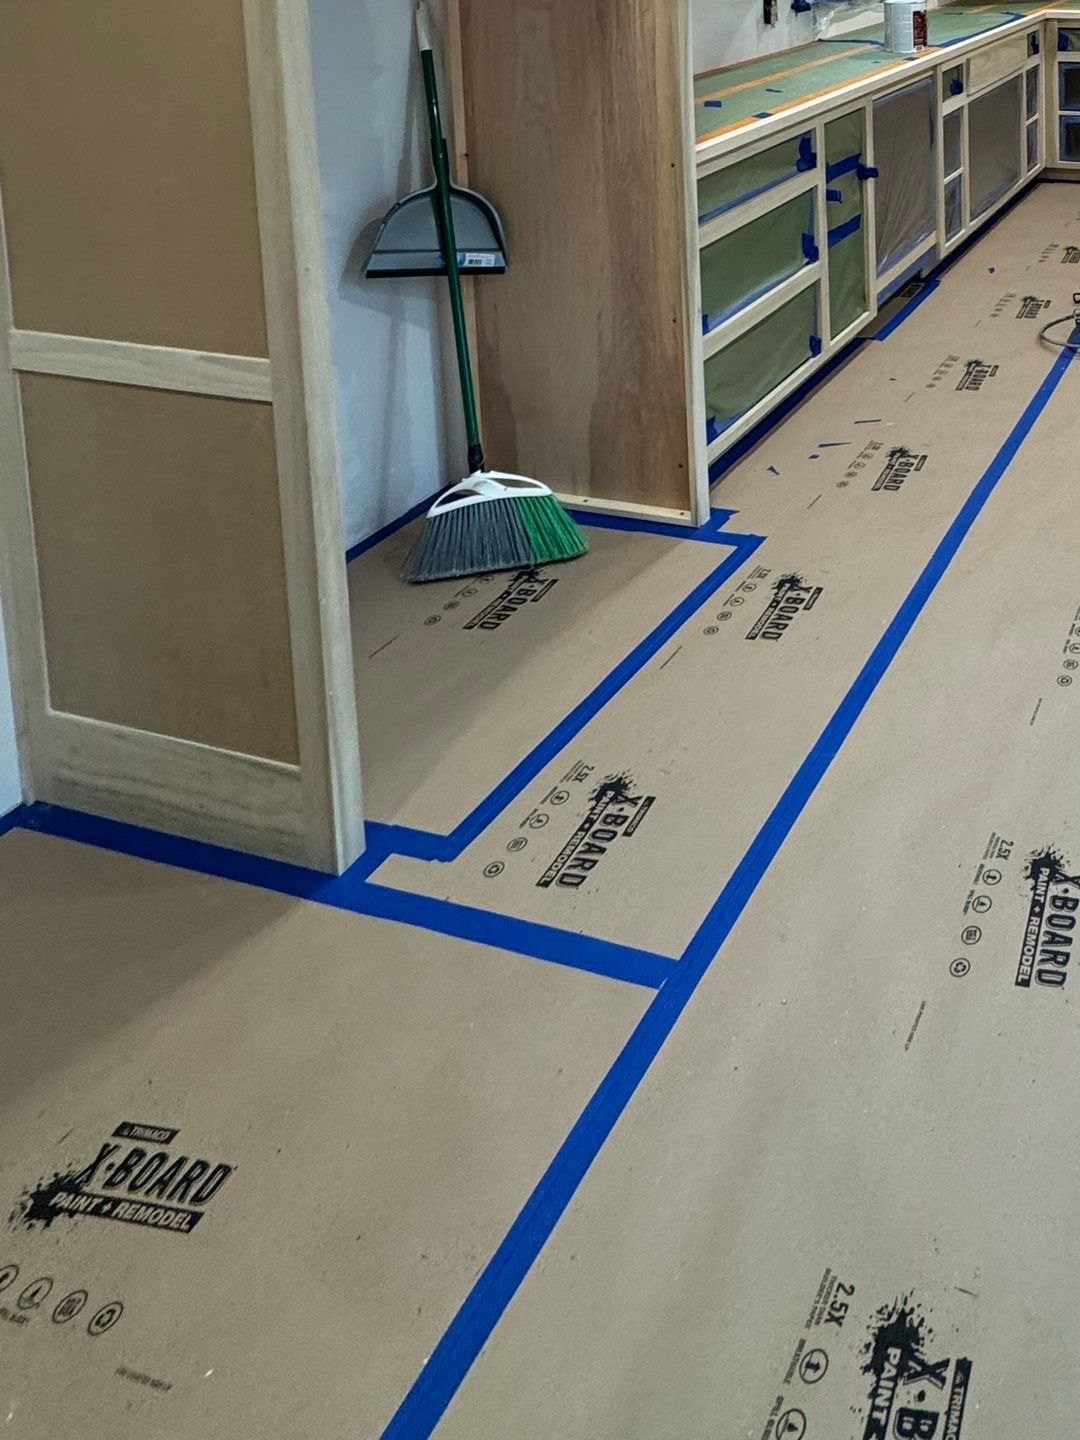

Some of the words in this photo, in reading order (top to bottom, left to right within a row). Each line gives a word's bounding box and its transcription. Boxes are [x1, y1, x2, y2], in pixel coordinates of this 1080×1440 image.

[1033, 867, 1050, 903] PAINT
[1017, 917, 1040, 982] REMODEL
[49, 1192, 103, 1213] PAINT
[111, 1201, 193, 1230] REMODEL
[824, 1282, 855, 1327] 2.5X
[872, 1347, 901, 1425] PAINT
[947, 1384, 964, 1440] TRIMAC
